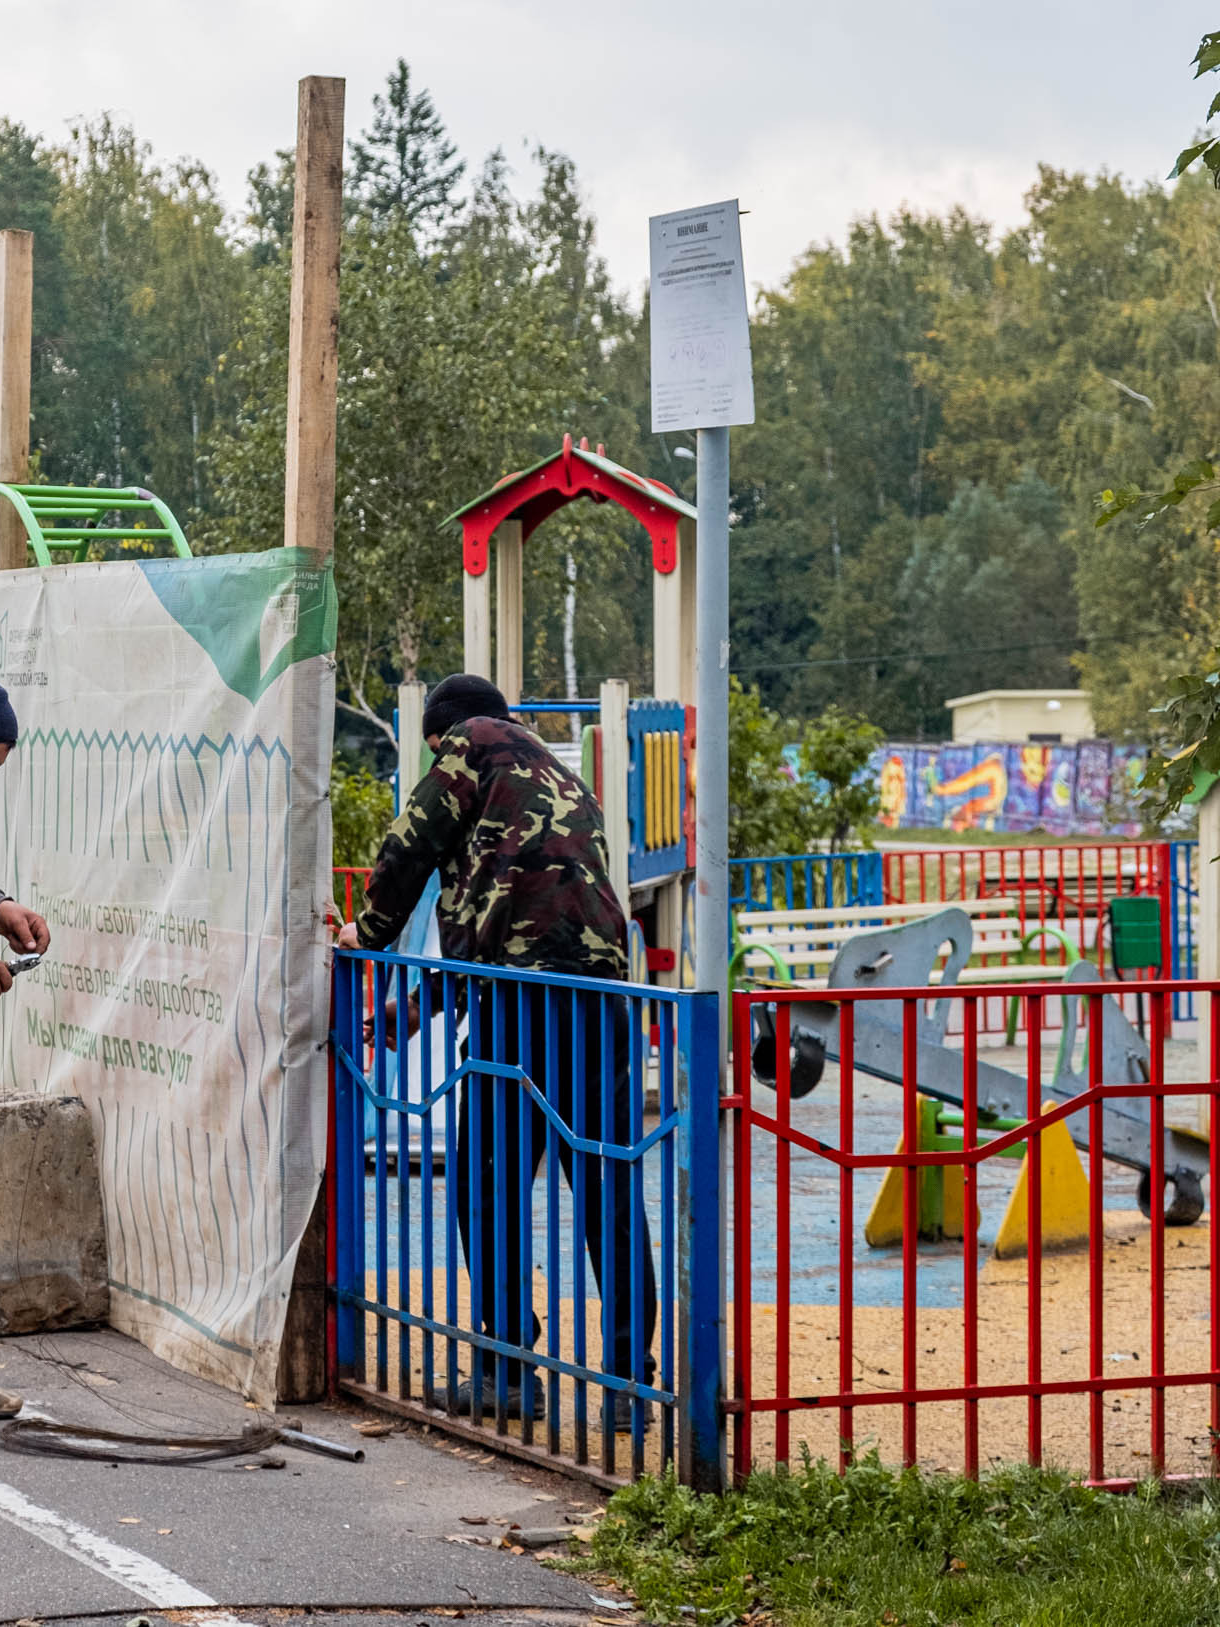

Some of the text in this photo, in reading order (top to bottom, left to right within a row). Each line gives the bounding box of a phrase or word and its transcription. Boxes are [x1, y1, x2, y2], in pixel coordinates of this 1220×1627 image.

[30, 882, 92, 931] Приносим
[96, 905, 135, 937] свои
[102, 1034, 136, 1073] для
[137, 1040, 166, 1077] вас
[167, 1048, 193, 1090] уют
